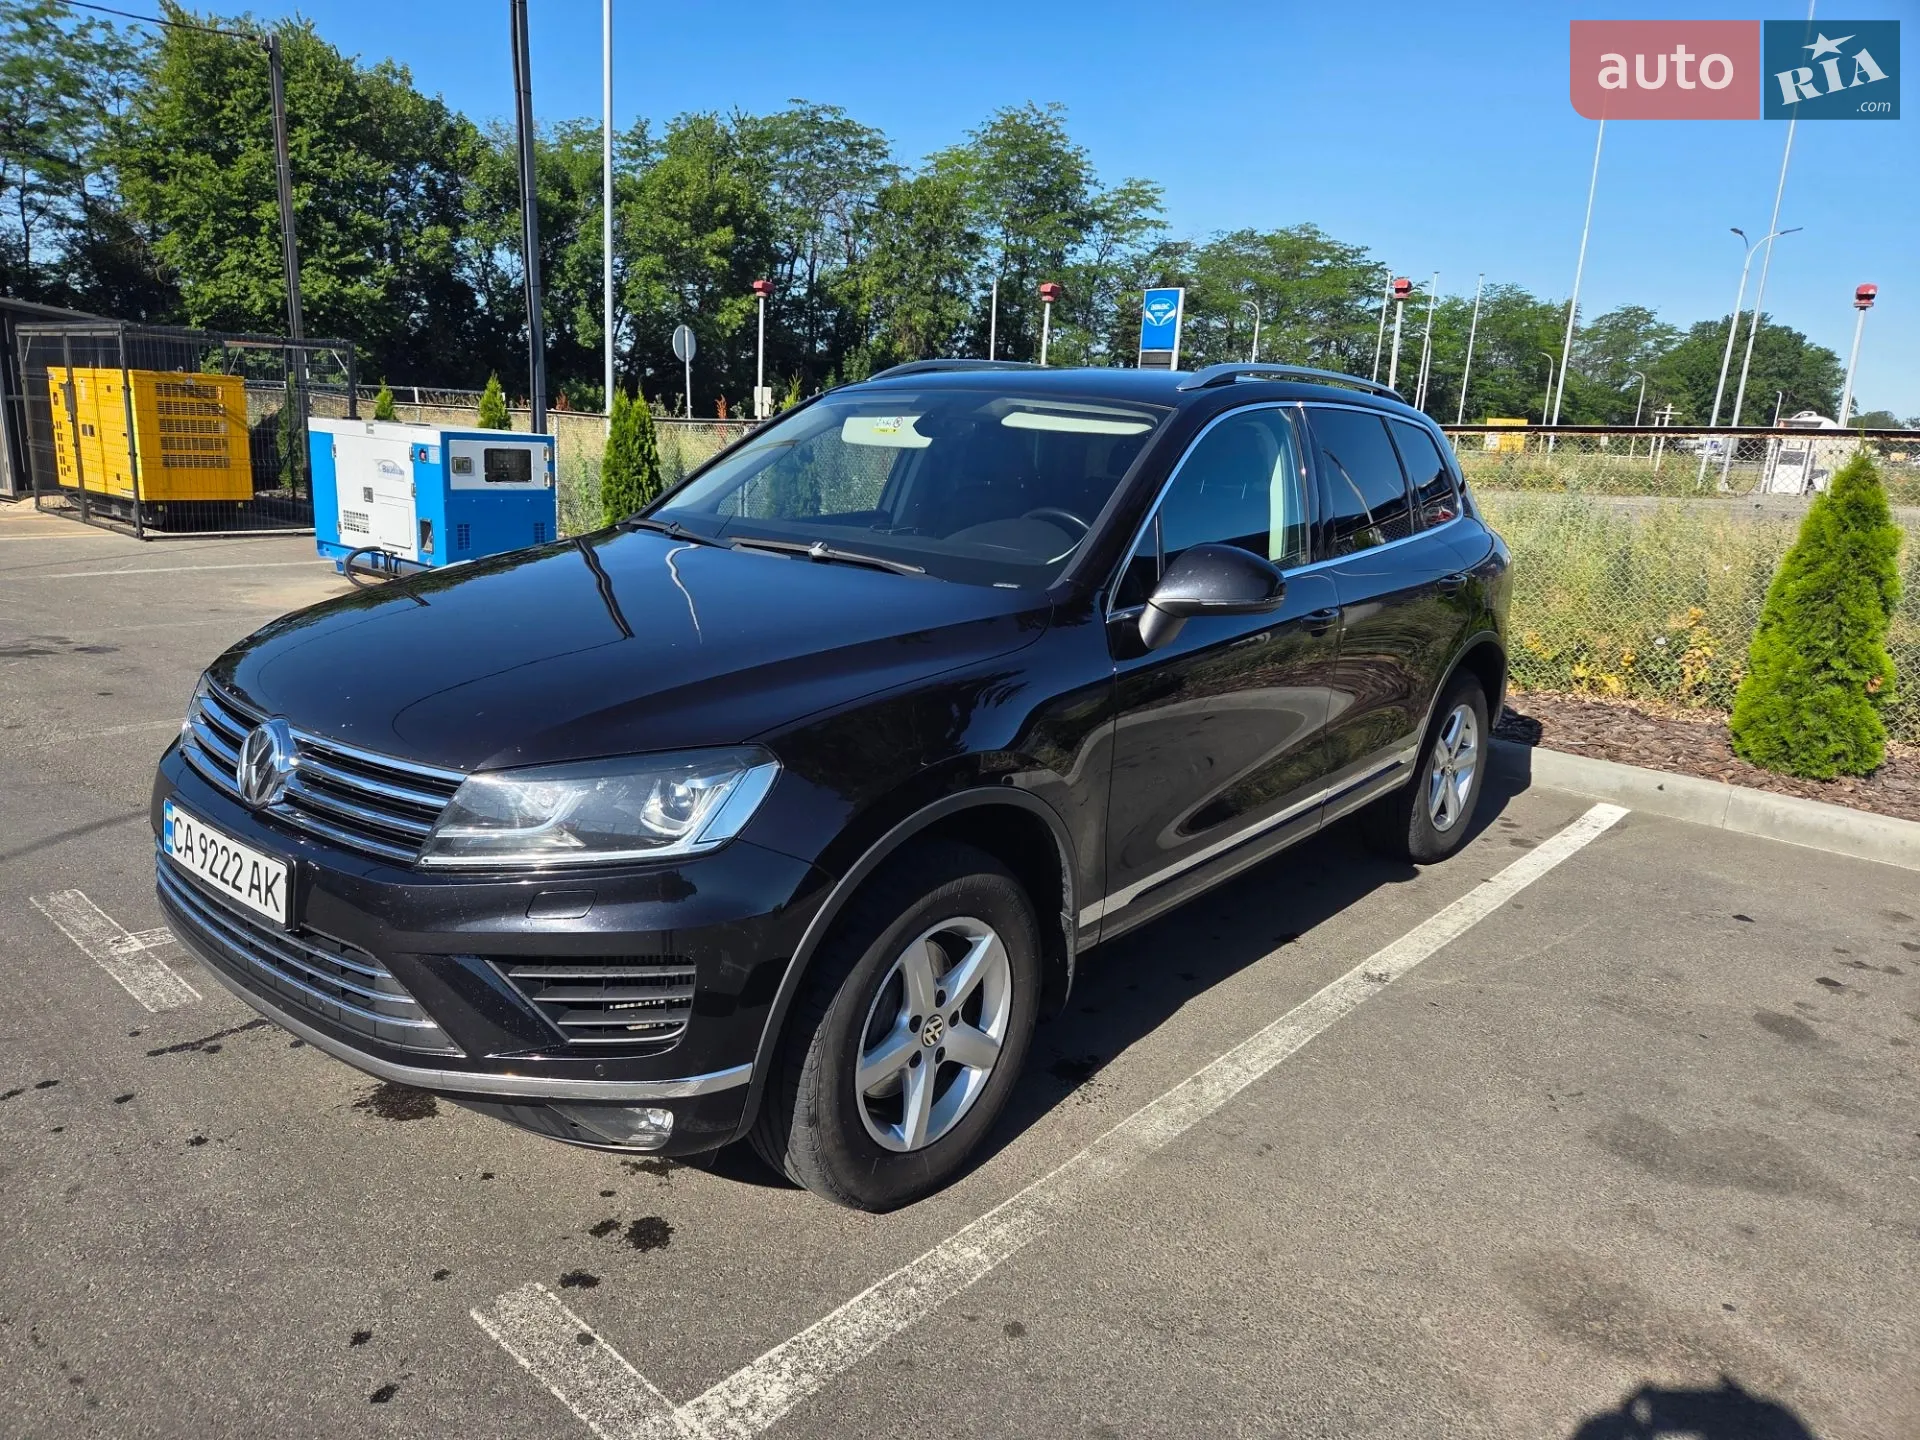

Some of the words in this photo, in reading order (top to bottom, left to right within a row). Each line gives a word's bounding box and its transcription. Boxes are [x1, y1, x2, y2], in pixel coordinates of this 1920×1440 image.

[173, 816, 195, 864] CA
[198, 832, 243, 894] 9222
[248, 859, 281, 913] AK
